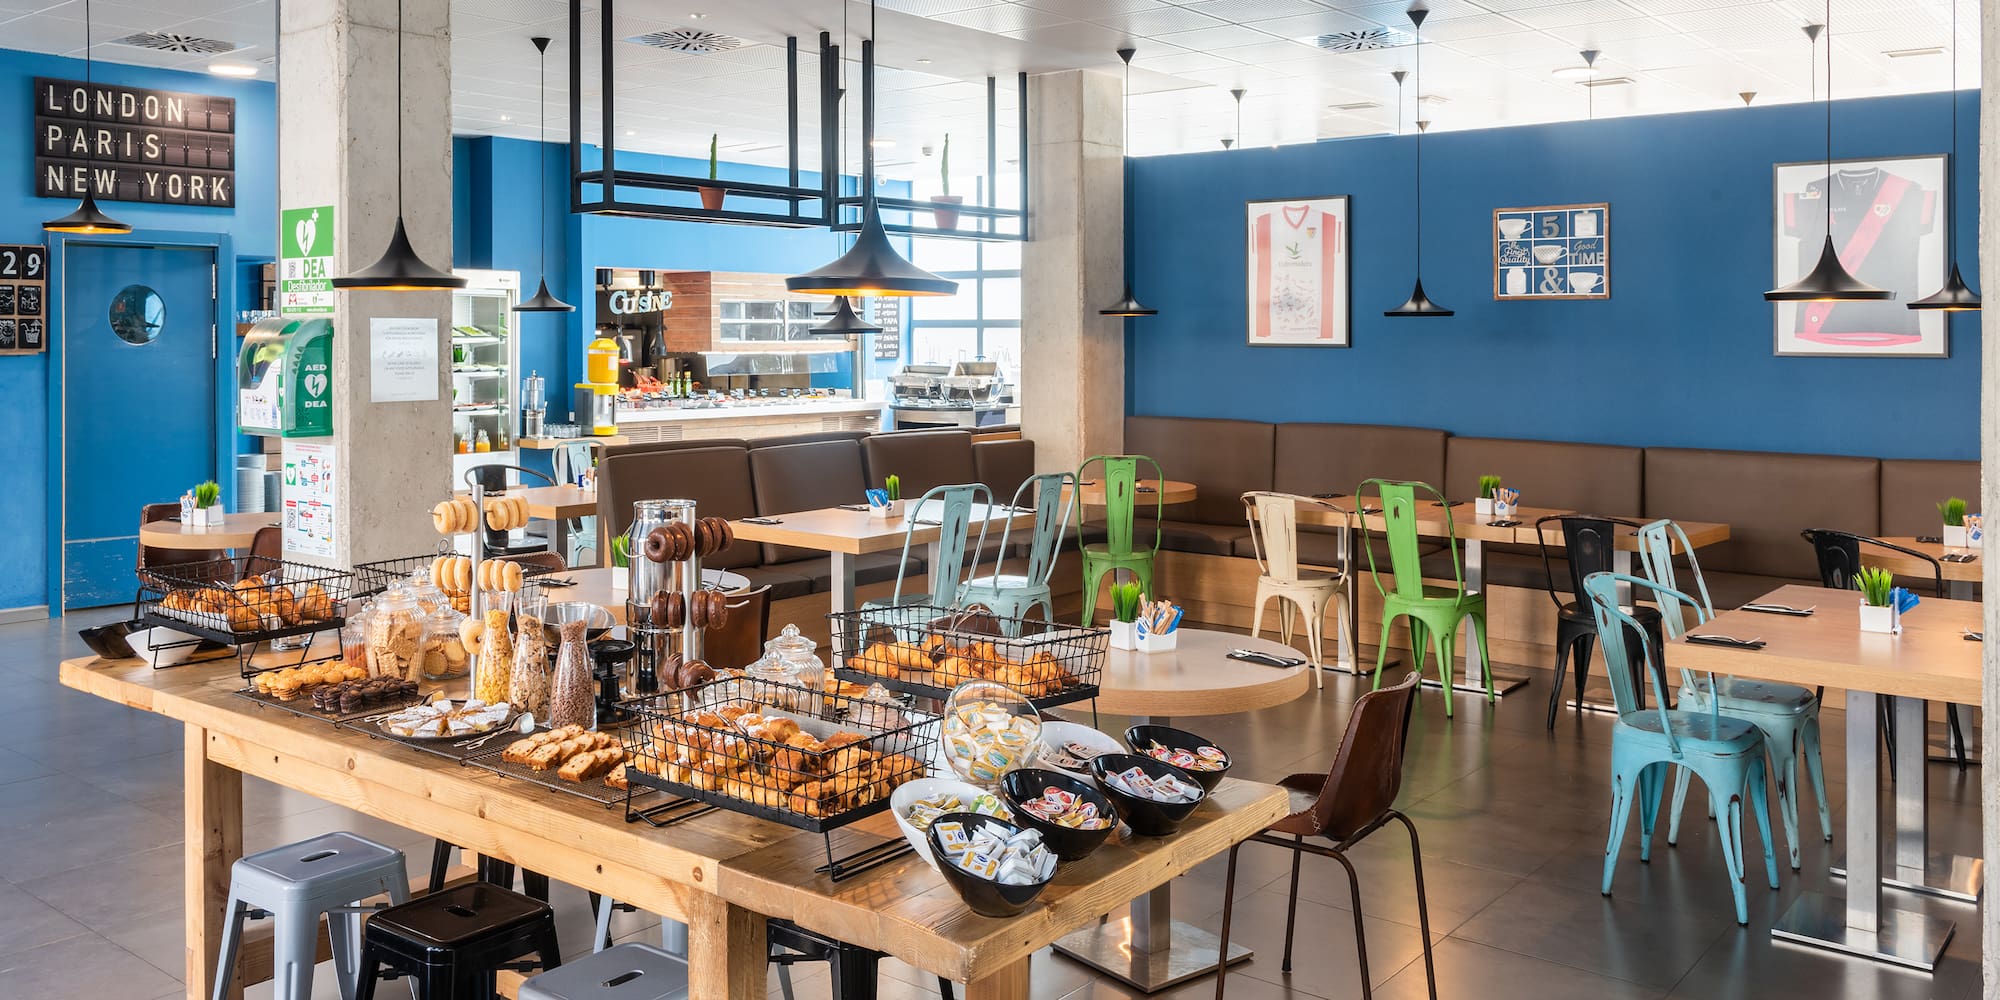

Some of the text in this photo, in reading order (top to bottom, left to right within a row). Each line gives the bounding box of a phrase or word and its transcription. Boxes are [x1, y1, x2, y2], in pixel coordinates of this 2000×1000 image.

[48, 85, 182, 122] LONDON
[48, 125, 159, 159] PARIS
[48, 165, 226, 201] NEW YORK
[1542, 216, 1560, 238] 5
[1574, 239, 1598, 254] Good
[303, 258, 326, 278] DEA
[1569, 252, 1604, 265] TIME
[305, 364, 327, 372] AED
[305, 400, 327, 408] DEA
